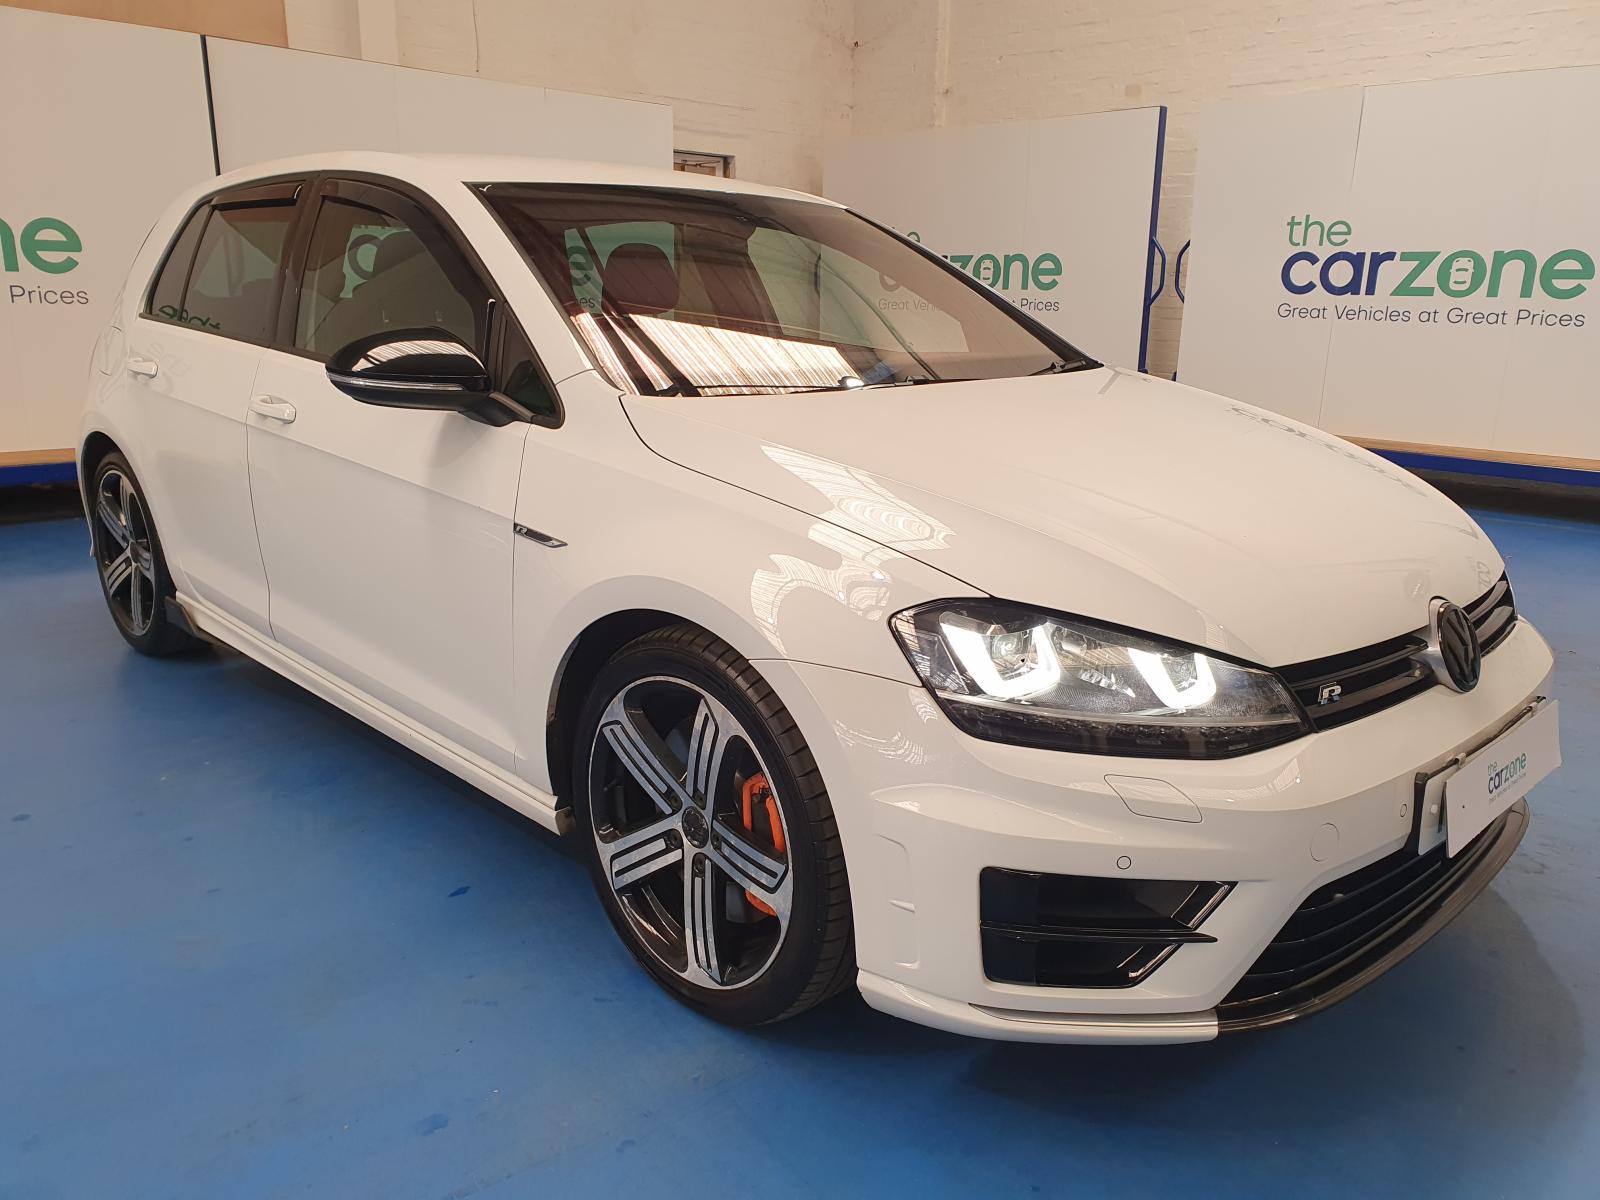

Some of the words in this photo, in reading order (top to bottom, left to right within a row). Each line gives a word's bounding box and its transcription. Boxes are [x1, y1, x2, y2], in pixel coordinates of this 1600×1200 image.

[1286, 214, 1352, 247] the
[1281, 248, 1596, 300] carzone
[9, 284, 89, 305] Prices
[1020, 298, 1060, 312] Prices
[1277, 302, 1328, 320] Great
[1334, 304, 1412, 323] Vehicles
[1418, 309, 1440, 324] at
[1446, 307, 1508, 325] Great
[1516, 309, 1586, 328] Prices
[1318, 682, 1342, 705] R
[1488, 752, 1527, 794] carzone
